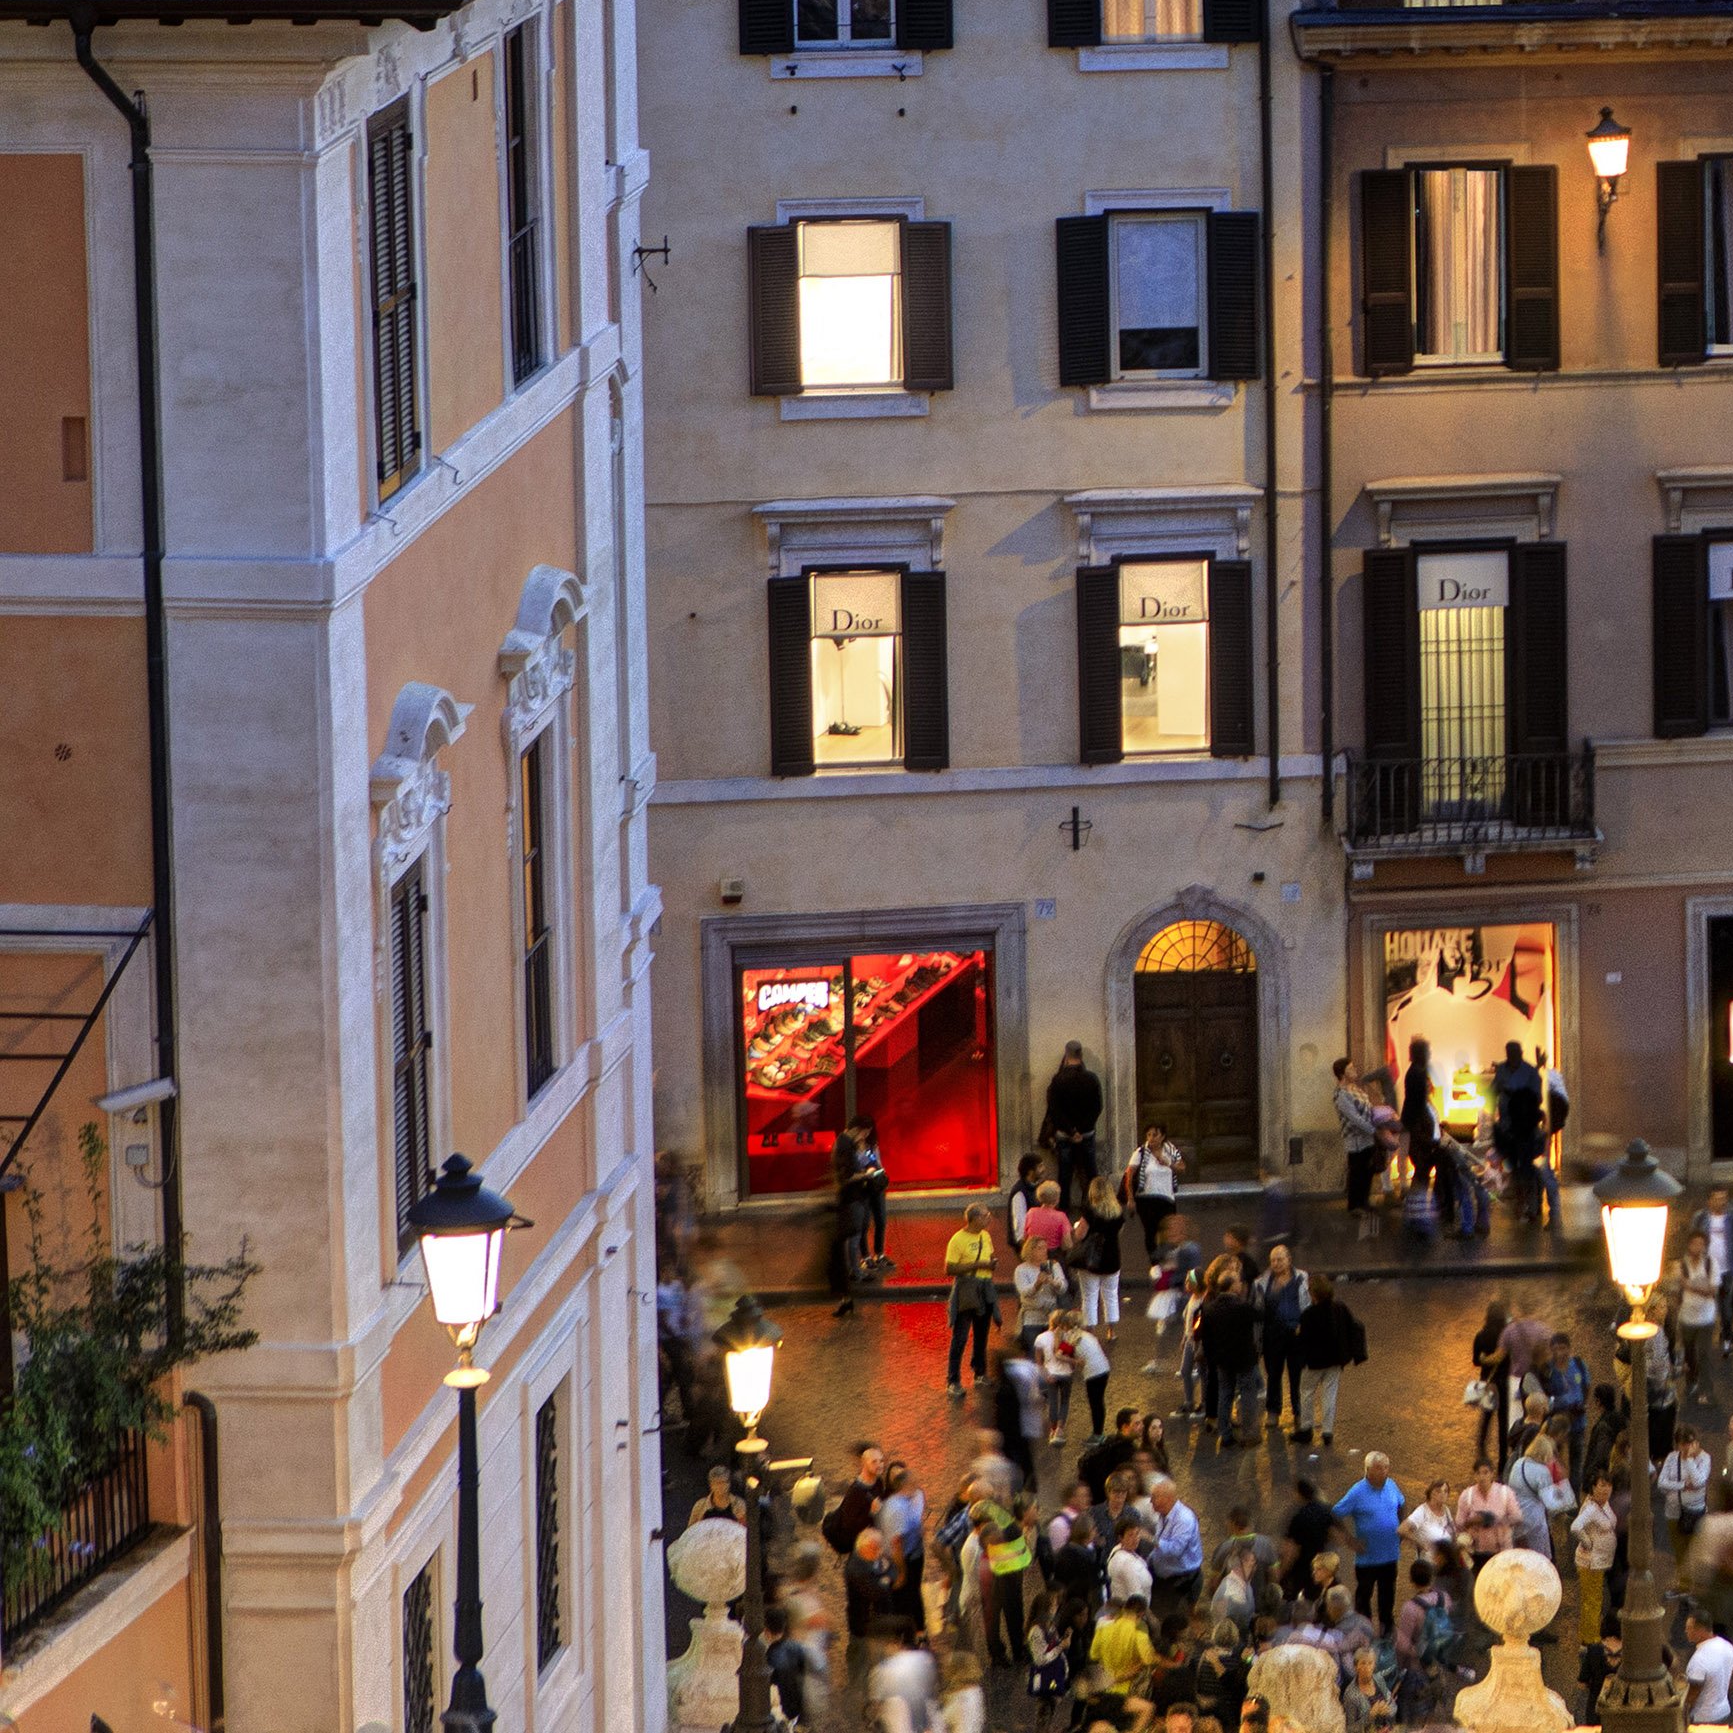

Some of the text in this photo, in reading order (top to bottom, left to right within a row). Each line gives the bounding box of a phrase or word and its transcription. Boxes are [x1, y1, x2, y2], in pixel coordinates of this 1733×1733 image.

[1438, 578, 1491, 601] Dior
[1139, 596, 1192, 618] Dior
[831, 609, 883, 631] Dior
[758, 981, 829, 1011] CAMPER
